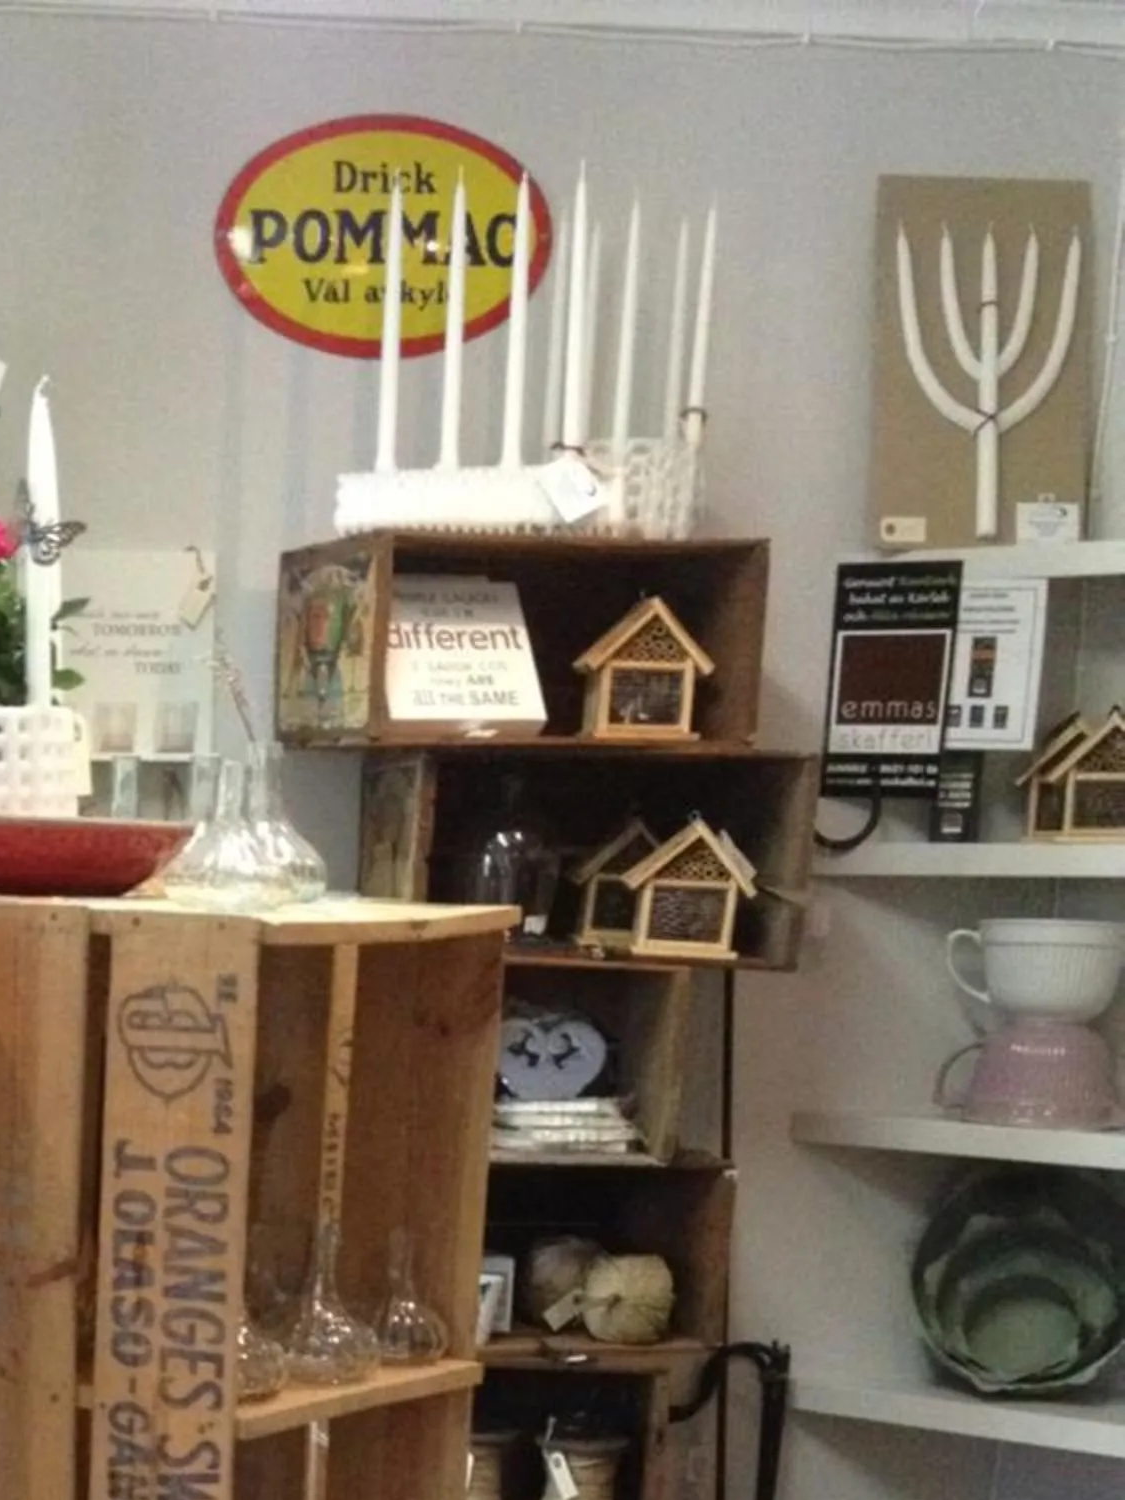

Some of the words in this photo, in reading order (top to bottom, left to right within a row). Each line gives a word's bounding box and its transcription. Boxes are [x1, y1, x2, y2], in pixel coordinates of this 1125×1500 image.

[333, 160, 437, 195] Drick
[248, 208, 518, 268] POMMAC
[387, 622, 523, 651] different
[469, 690, 521, 706] SAME
[841, 699, 937, 720] emmas
[158, 1145, 231, 1412] ORANGES
